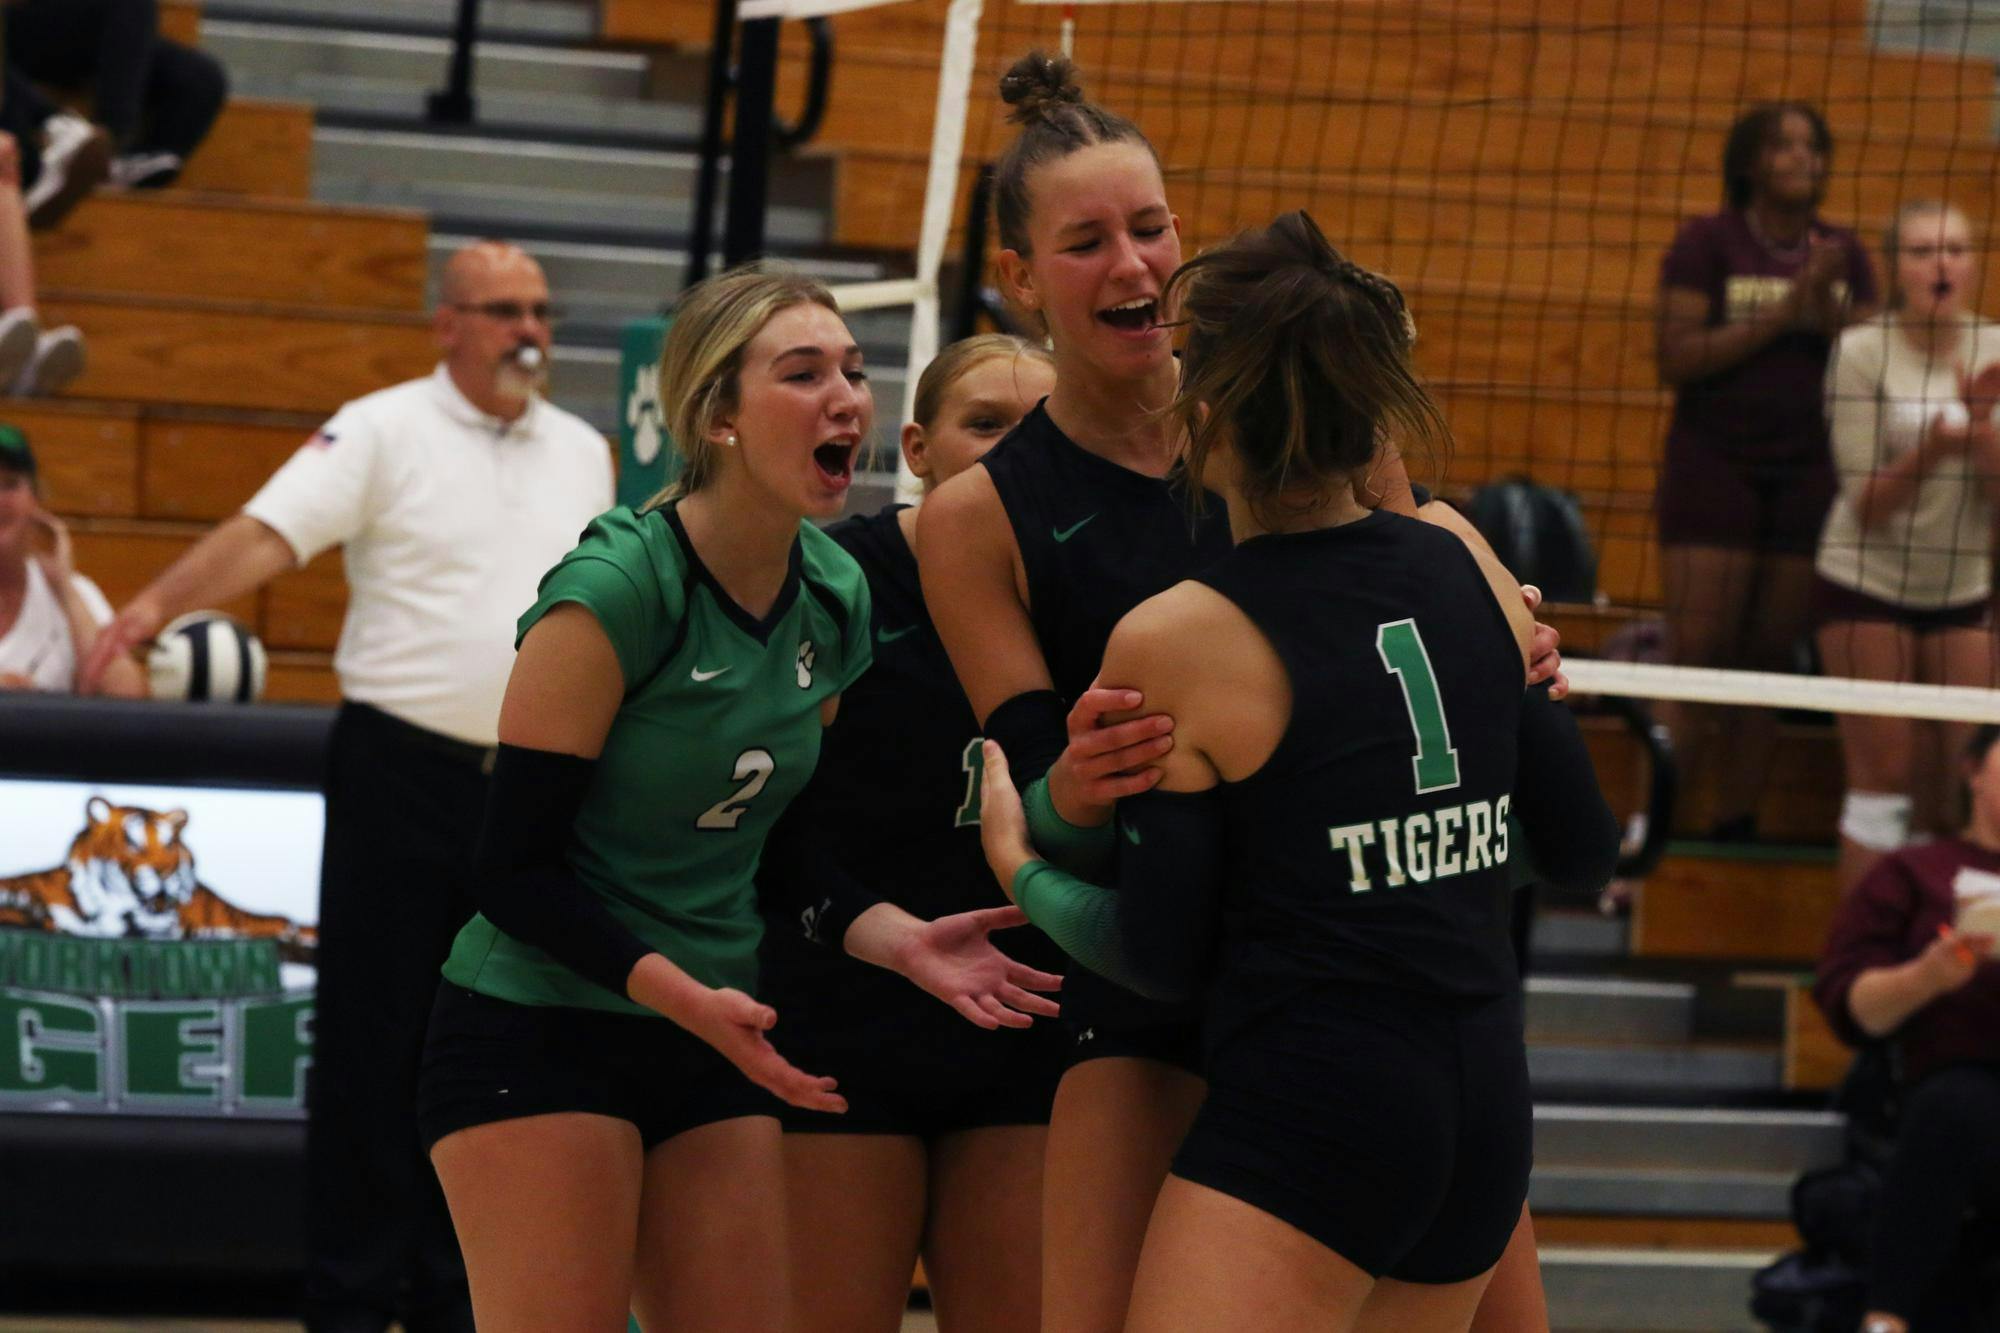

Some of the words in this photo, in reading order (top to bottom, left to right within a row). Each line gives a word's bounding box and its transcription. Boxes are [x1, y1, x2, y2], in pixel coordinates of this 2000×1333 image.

[1376, 617, 1461, 795] 1
[695, 747, 775, 831] 2
[1329, 794, 1511, 893] TIGERS
